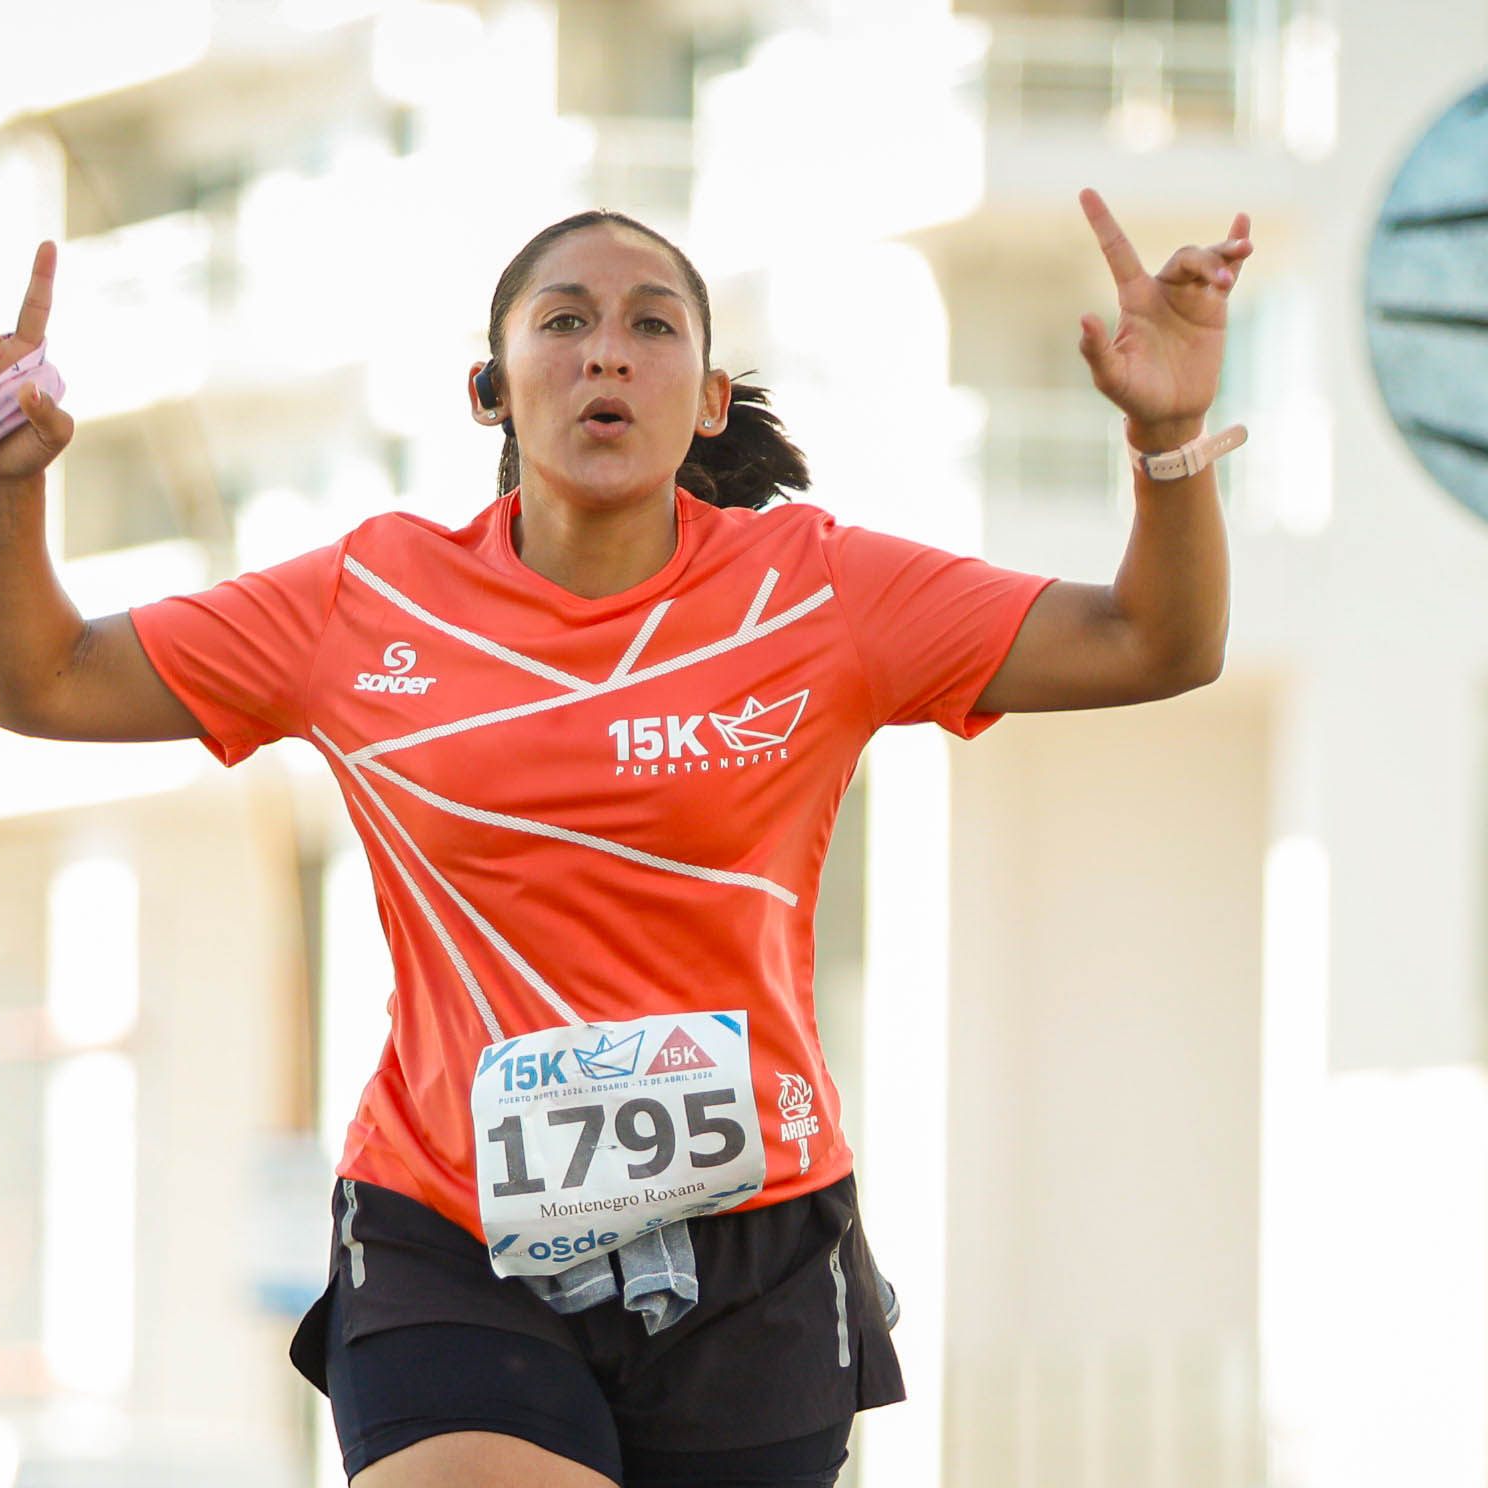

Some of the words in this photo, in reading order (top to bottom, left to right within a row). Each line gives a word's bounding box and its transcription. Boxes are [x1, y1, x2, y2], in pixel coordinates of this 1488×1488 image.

[608, 715, 709, 761] 15K
[615, 760, 709, 776] PUERTO
[719, 748, 788, 769] NORTE
[498, 1049, 568, 1092] 15K
[660, 1045, 700, 1067] 15K
[498, 1095, 531, 1105] PUERTO
[533, 1090, 559, 1101] NORTE
[591, 1082, 629, 1093] ROSARIO
[651, 1077, 662, 1086] DE
[664, 1074, 690, 1084] ABRIL
[487, 1087, 746, 1198] 1795
[780, 1115, 819, 1142] ARDEC
[540, 1190, 640, 1219] Montenegro
[644, 1181, 705, 1203] Roxana
[528, 1228, 619, 1262] osde
